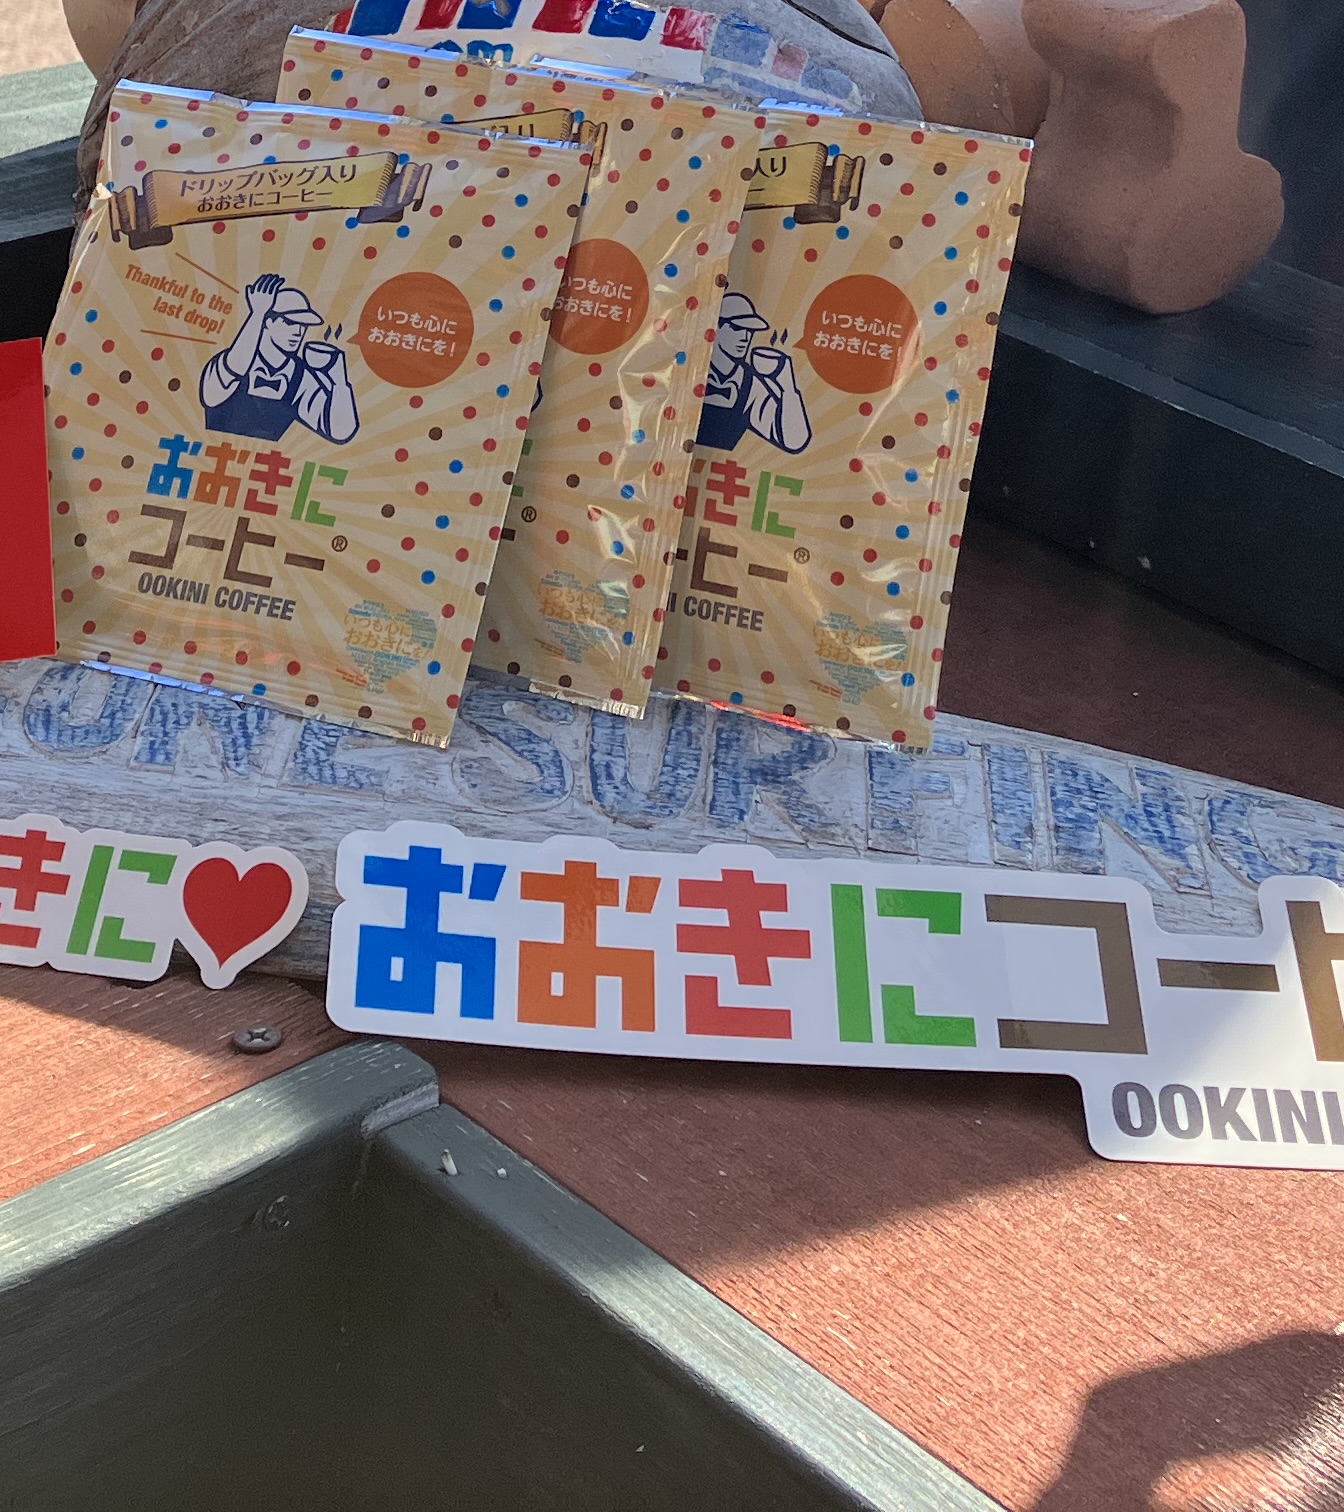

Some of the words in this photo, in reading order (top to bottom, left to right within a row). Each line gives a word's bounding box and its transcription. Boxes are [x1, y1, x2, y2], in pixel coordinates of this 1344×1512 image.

[180, 164, 357, 197] ドリップバッグ入り
[197, 188, 333, 214] おおきにコーヒー
[125, 264, 189, 299] Thankful
[190, 288, 205, 305] to
[208, 294, 233, 315] the
[153, 296, 183, 319] last
[184, 309, 226, 334] drop!
[377, 306, 457, 336] いつも心に
[821, 310, 902, 339] いつも心に
[367, 326, 457, 358] おおきにを！
[146, 434, 349, 527] おおきに
[138, 572, 210, 605] OOKINI
[214, 586, 296, 621] COFFEE
[683, 596, 765, 632] COFFEE
